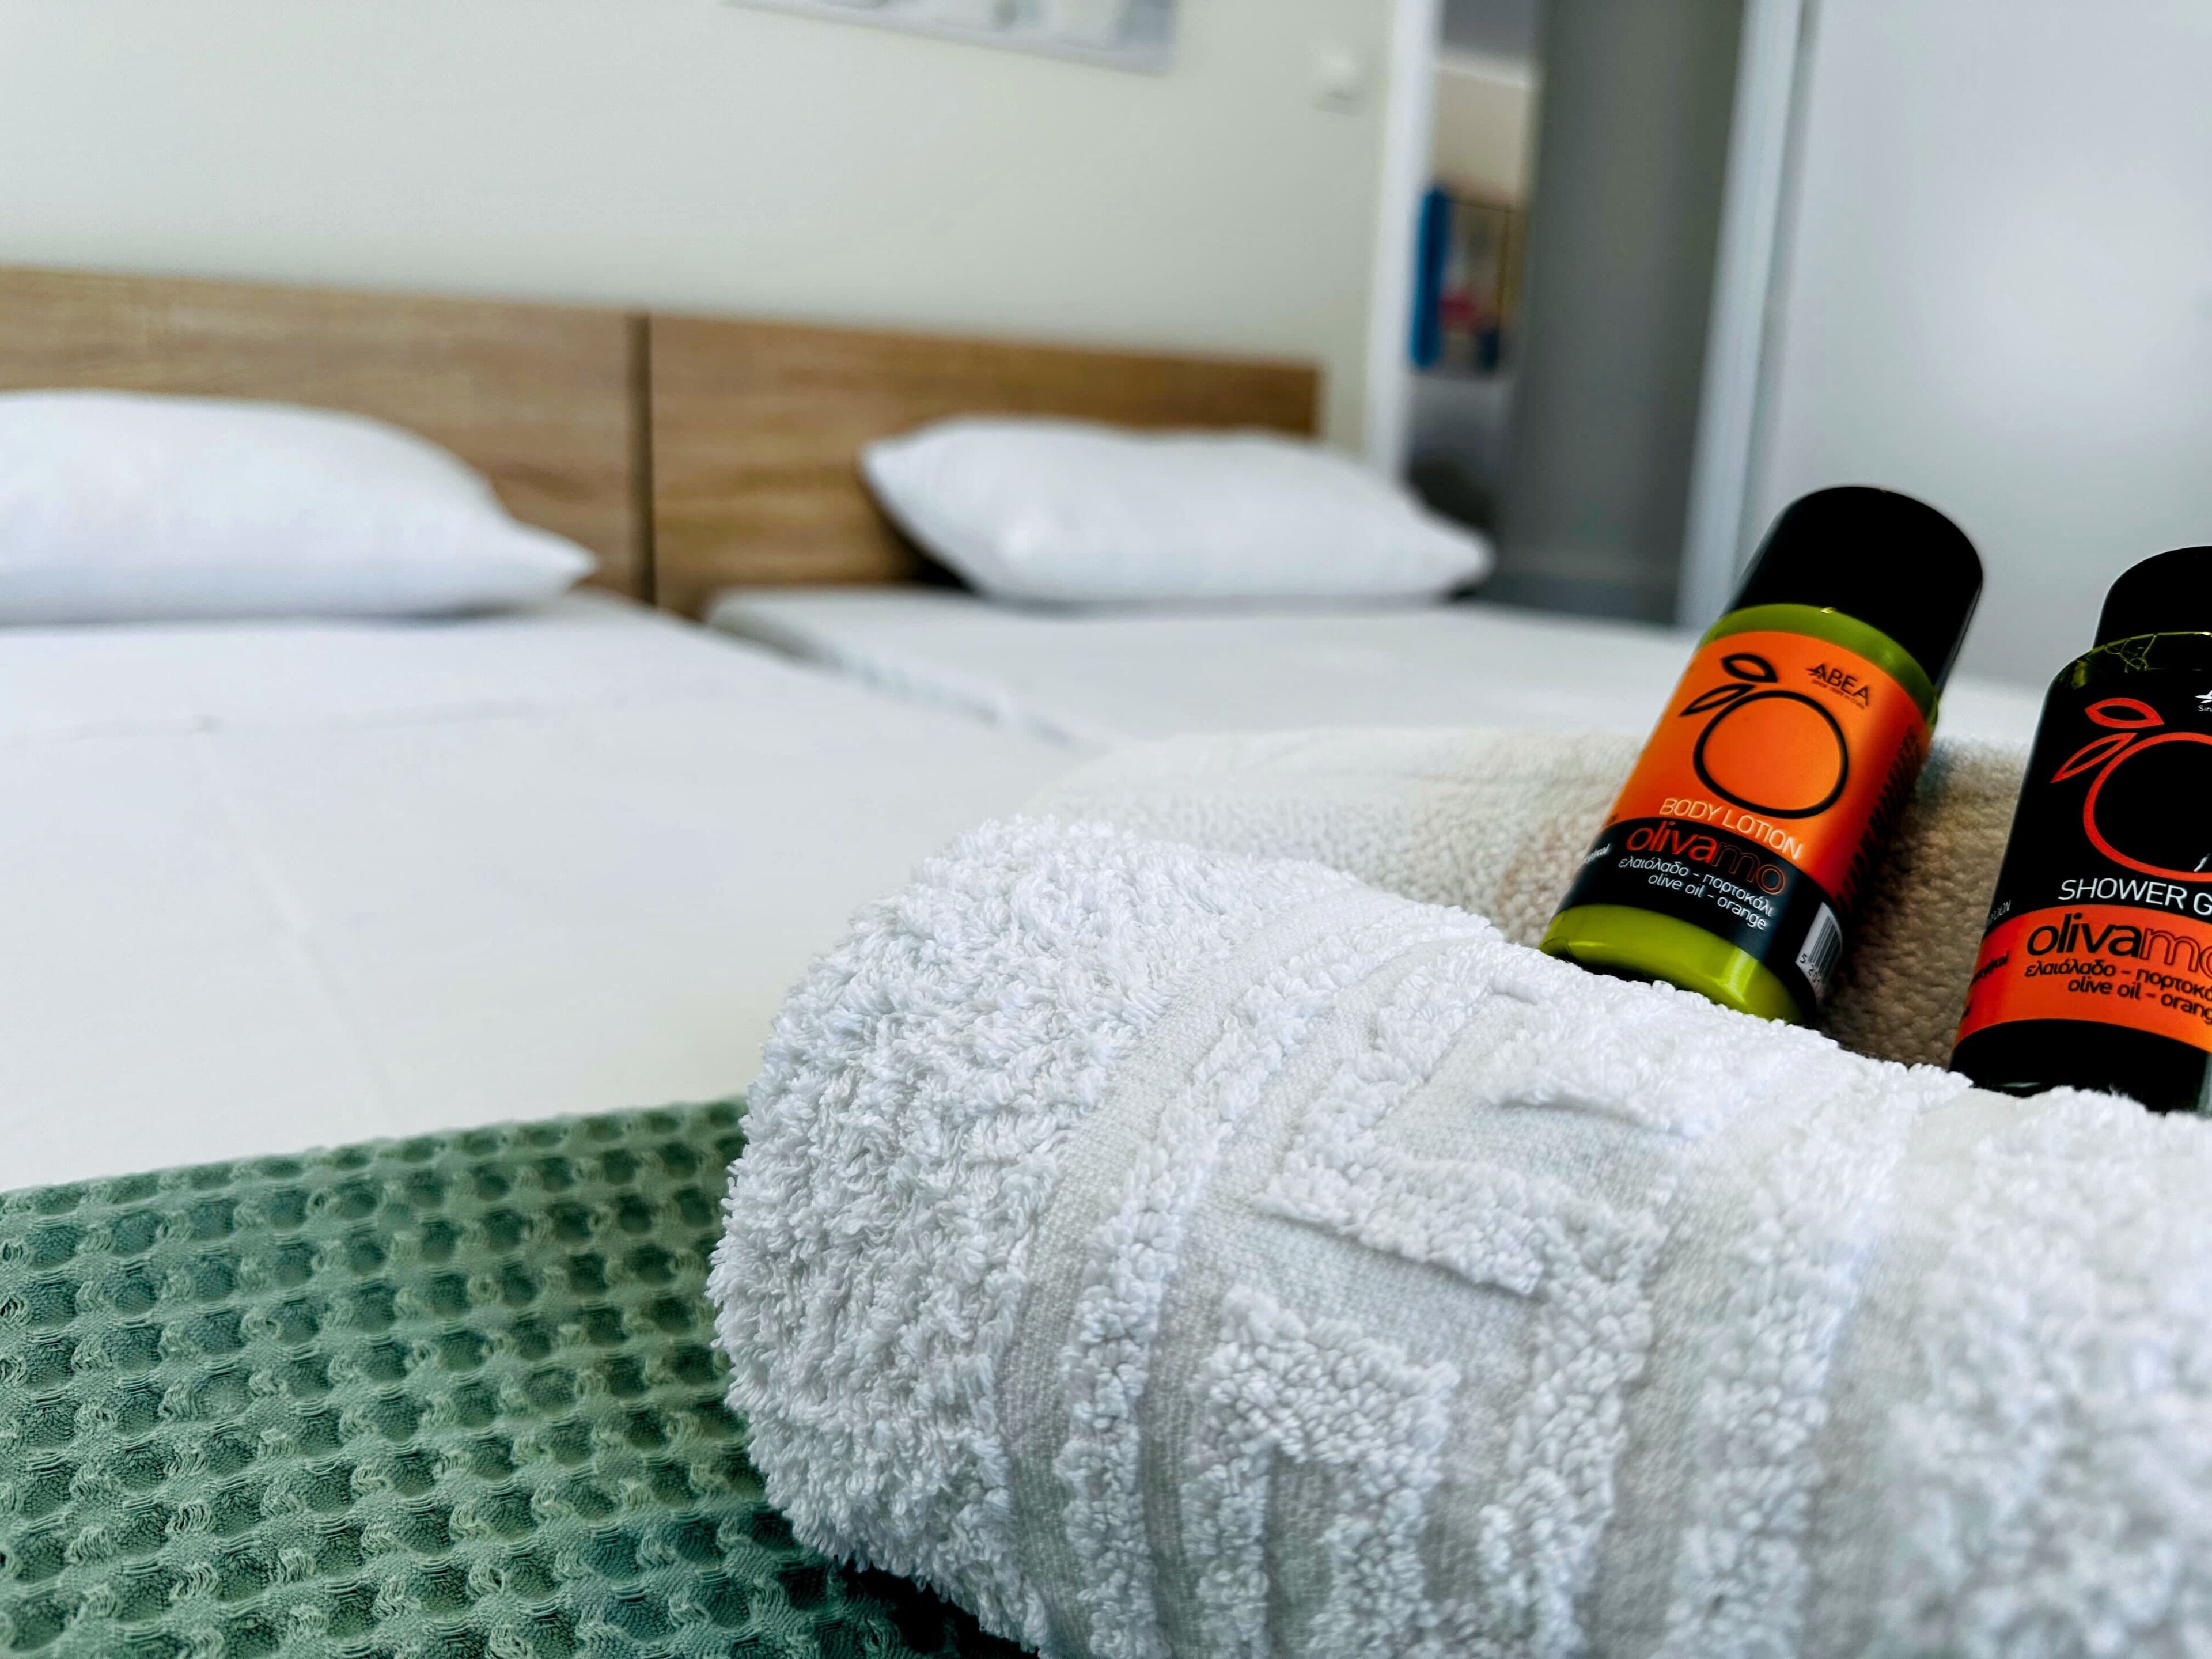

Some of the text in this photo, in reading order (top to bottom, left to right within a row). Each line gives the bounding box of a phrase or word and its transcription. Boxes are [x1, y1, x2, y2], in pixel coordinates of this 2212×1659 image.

[1806, 664, 1868, 706] ABEA
[1659, 798, 1804, 860] BODY LOTION
[1626, 821, 1786, 895] olivamo
[1618, 856, 1689, 876] ελαιόλαδο
[1702, 874, 1774, 917] πορτοκάλι
[1647, 873, 1683, 891] olive
[1685, 884, 1705, 898] oil
[1717, 897, 1767, 930] orange
[2058, 878, 2187, 910] SHOWER
[2025, 958, 2116, 978] ελαιόλαδο
[2068, 976, 2112, 994] olive
[2118, 982, 2142, 999] oil
